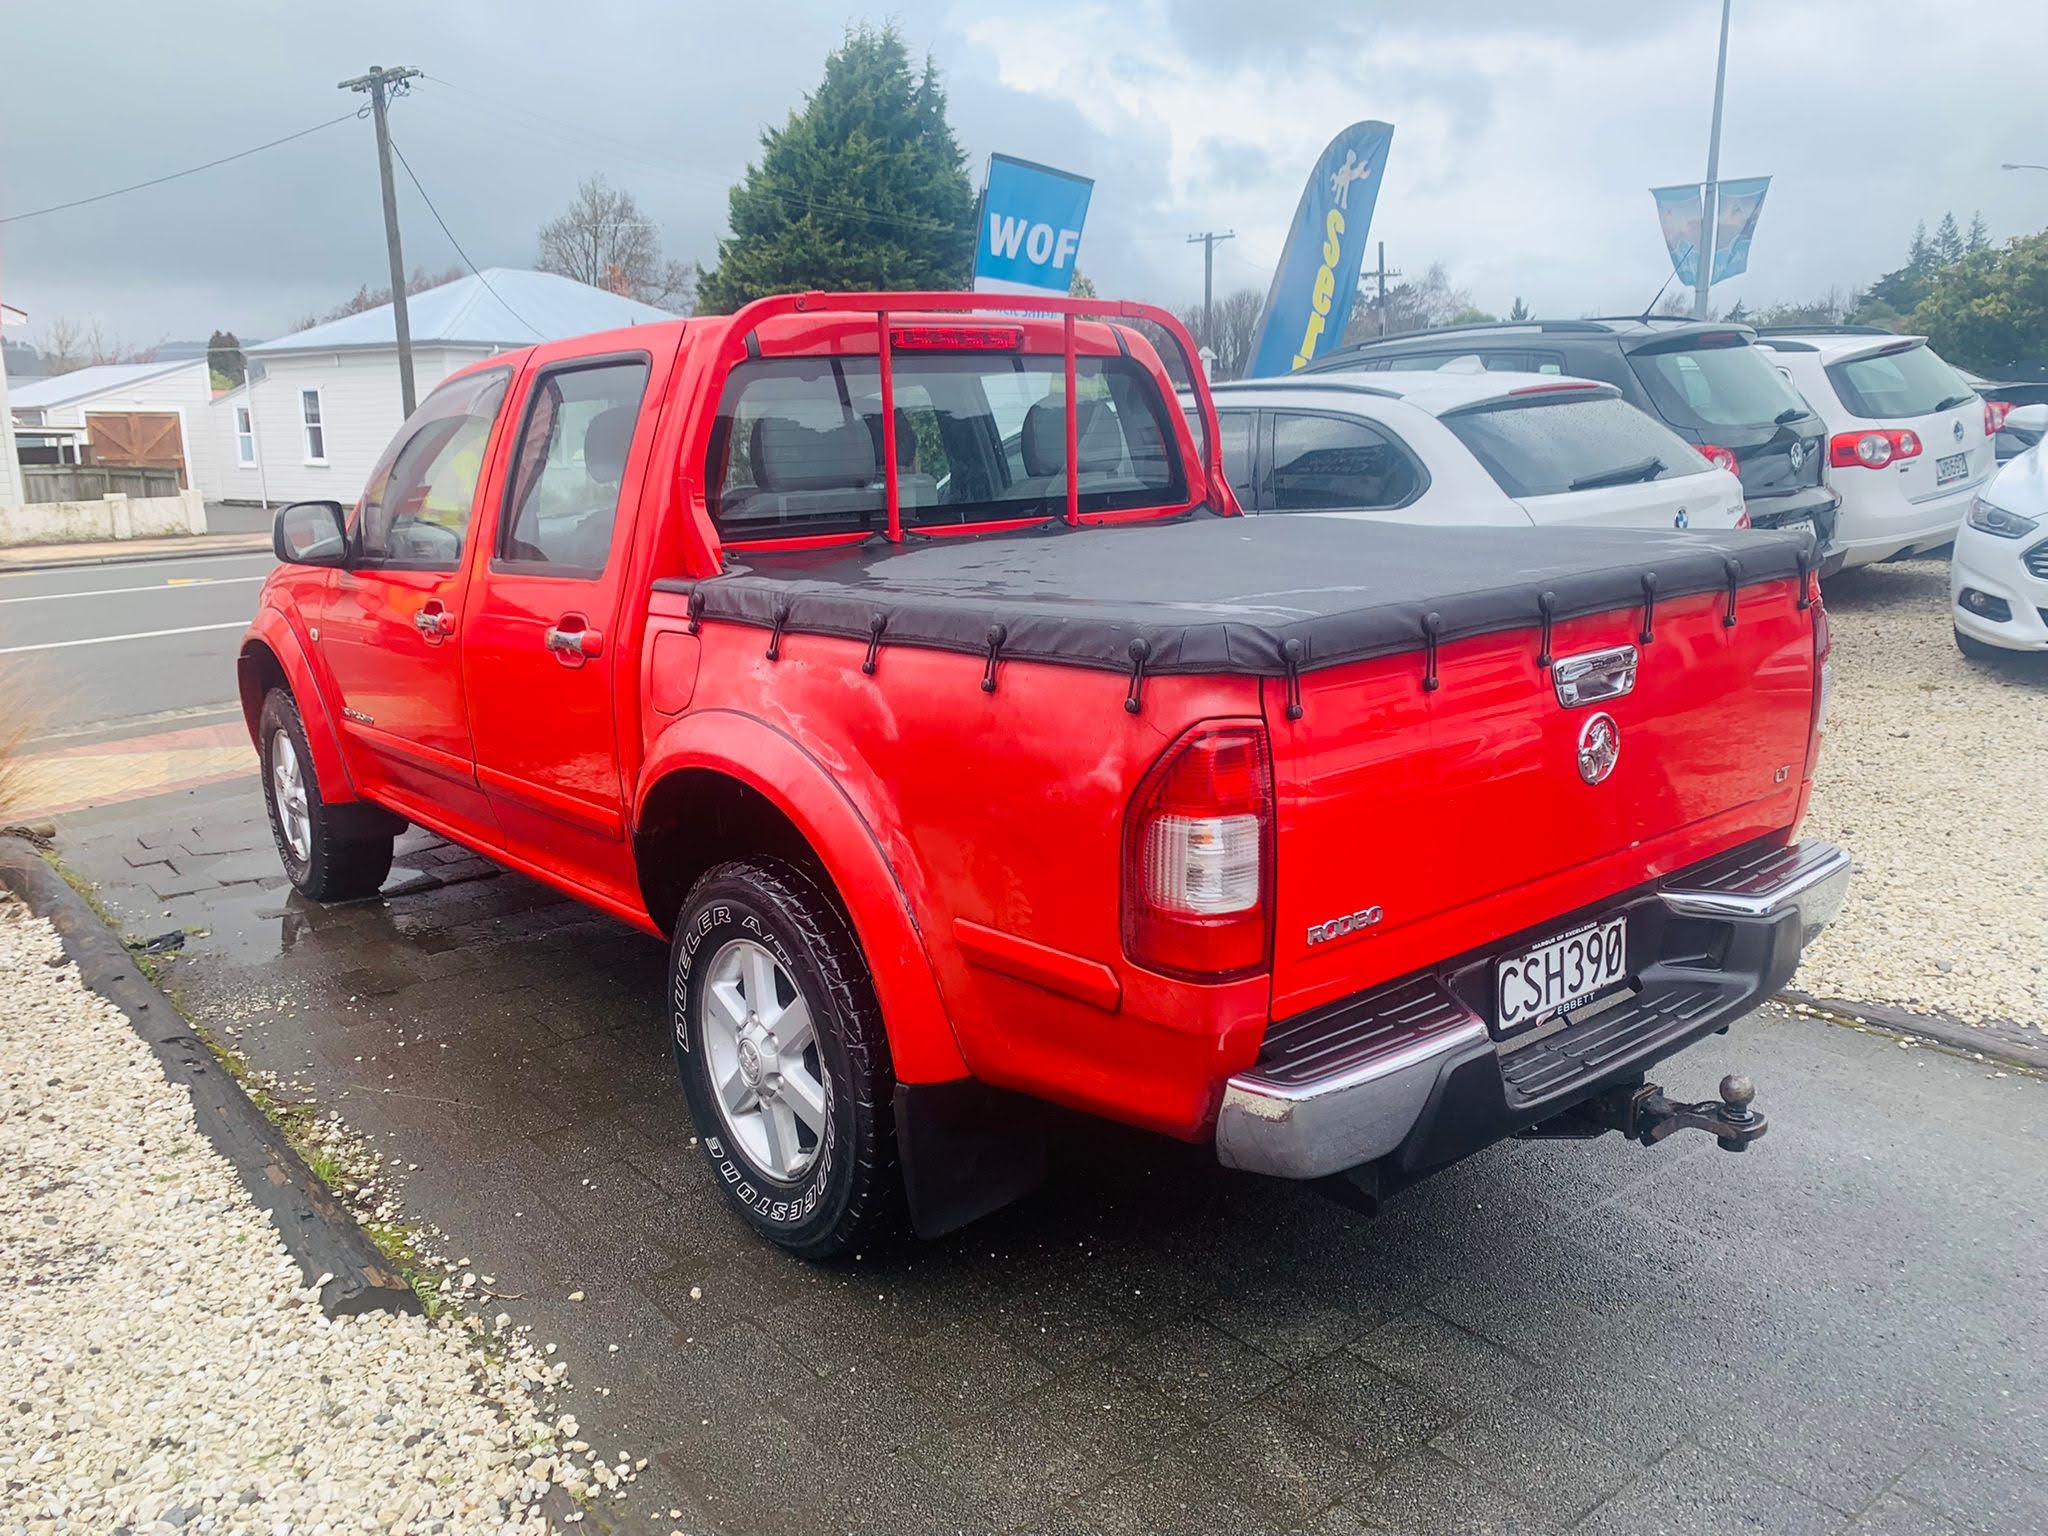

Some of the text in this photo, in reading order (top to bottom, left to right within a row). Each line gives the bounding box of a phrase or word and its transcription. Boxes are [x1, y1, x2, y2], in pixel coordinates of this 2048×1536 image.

[990, 213, 1080, 269] WOF
[1775, 765, 1791, 783] LT
[1307, 905, 1384, 945] RODEO
[1556, 933, 1564, 942] OF
[673, 906, 793, 1053] DUELER A/T
[1500, 924, 1623, 1022] CSH390
[1557, 992, 1596, 1015] EBBETT
[705, 1066, 836, 1221] BRIDGESTONE
